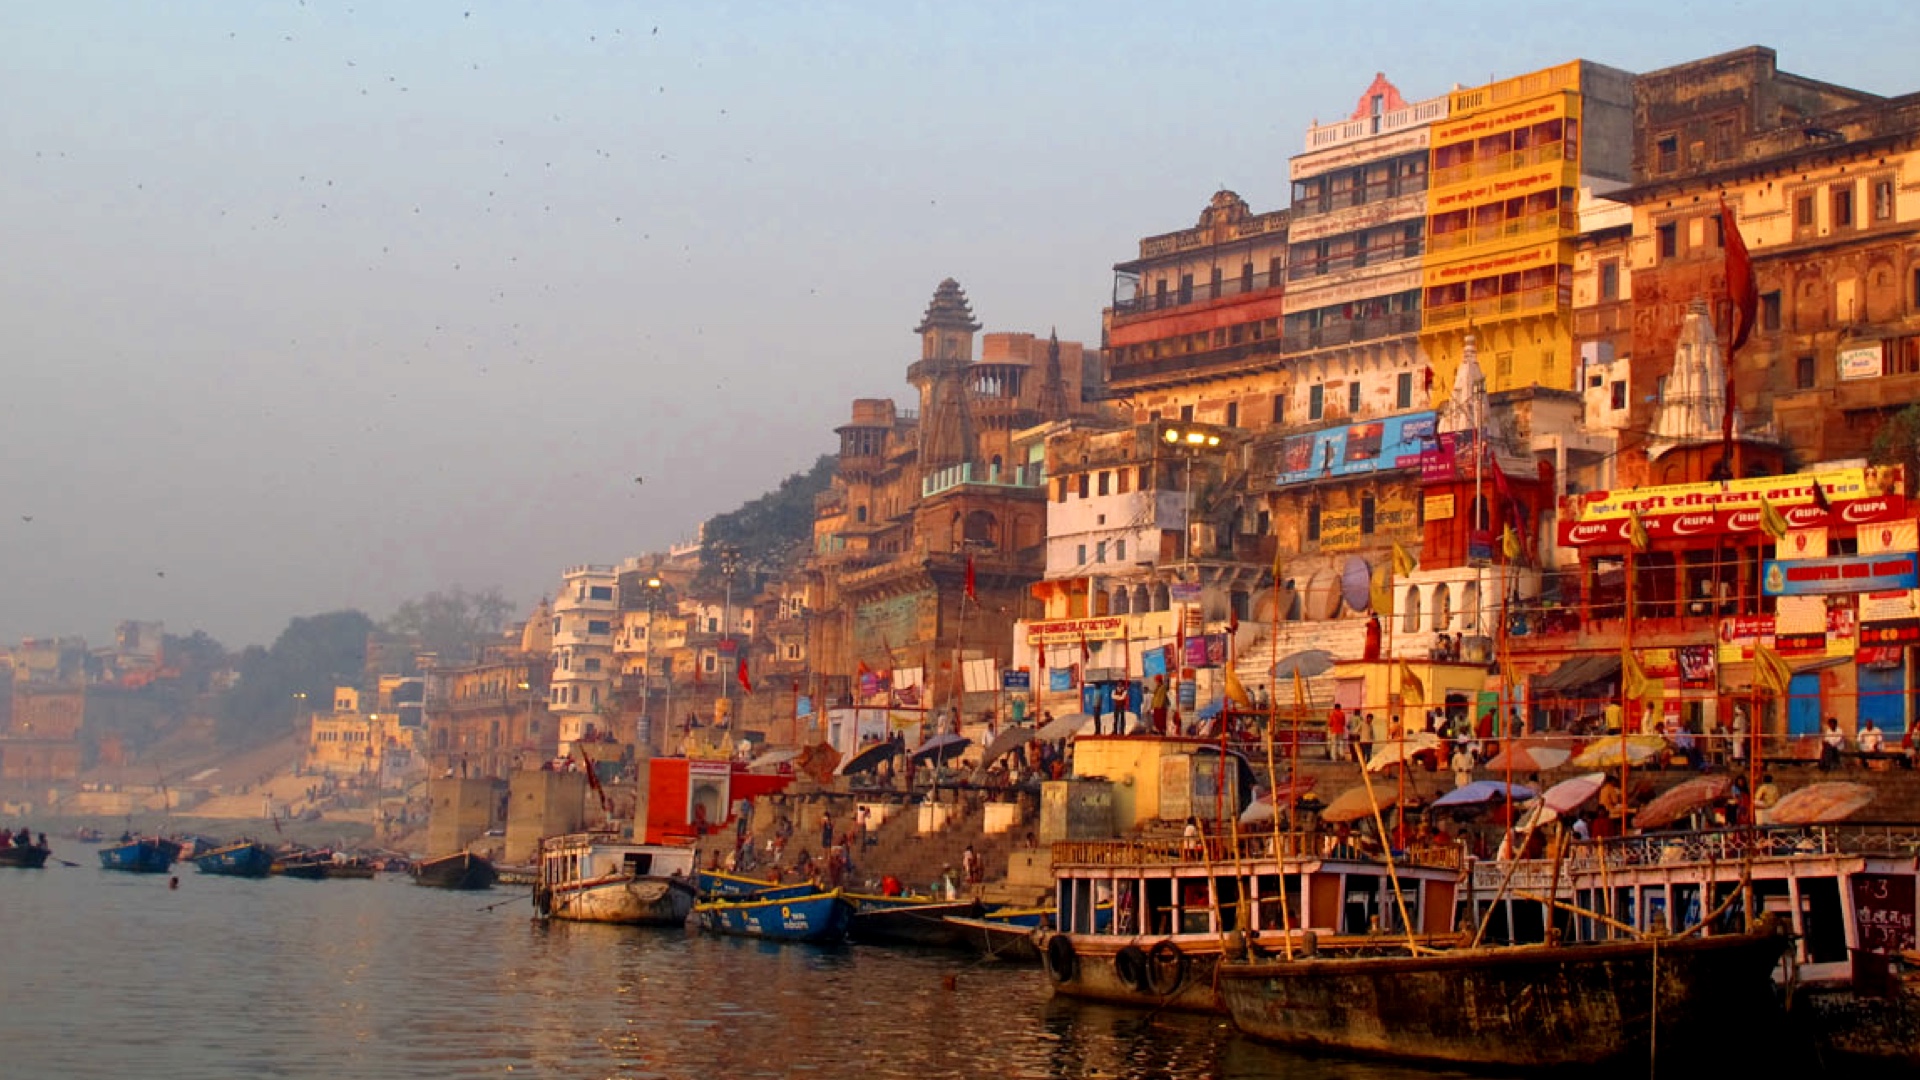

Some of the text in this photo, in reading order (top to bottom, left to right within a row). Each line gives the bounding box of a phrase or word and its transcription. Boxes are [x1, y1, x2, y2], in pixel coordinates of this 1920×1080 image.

[1854, 501, 1888, 512] RUPA
[1683, 515, 1715, 526] RUPA
[1738, 512, 1762, 522] RUP
[1578, 524, 1608, 535] RUPA
